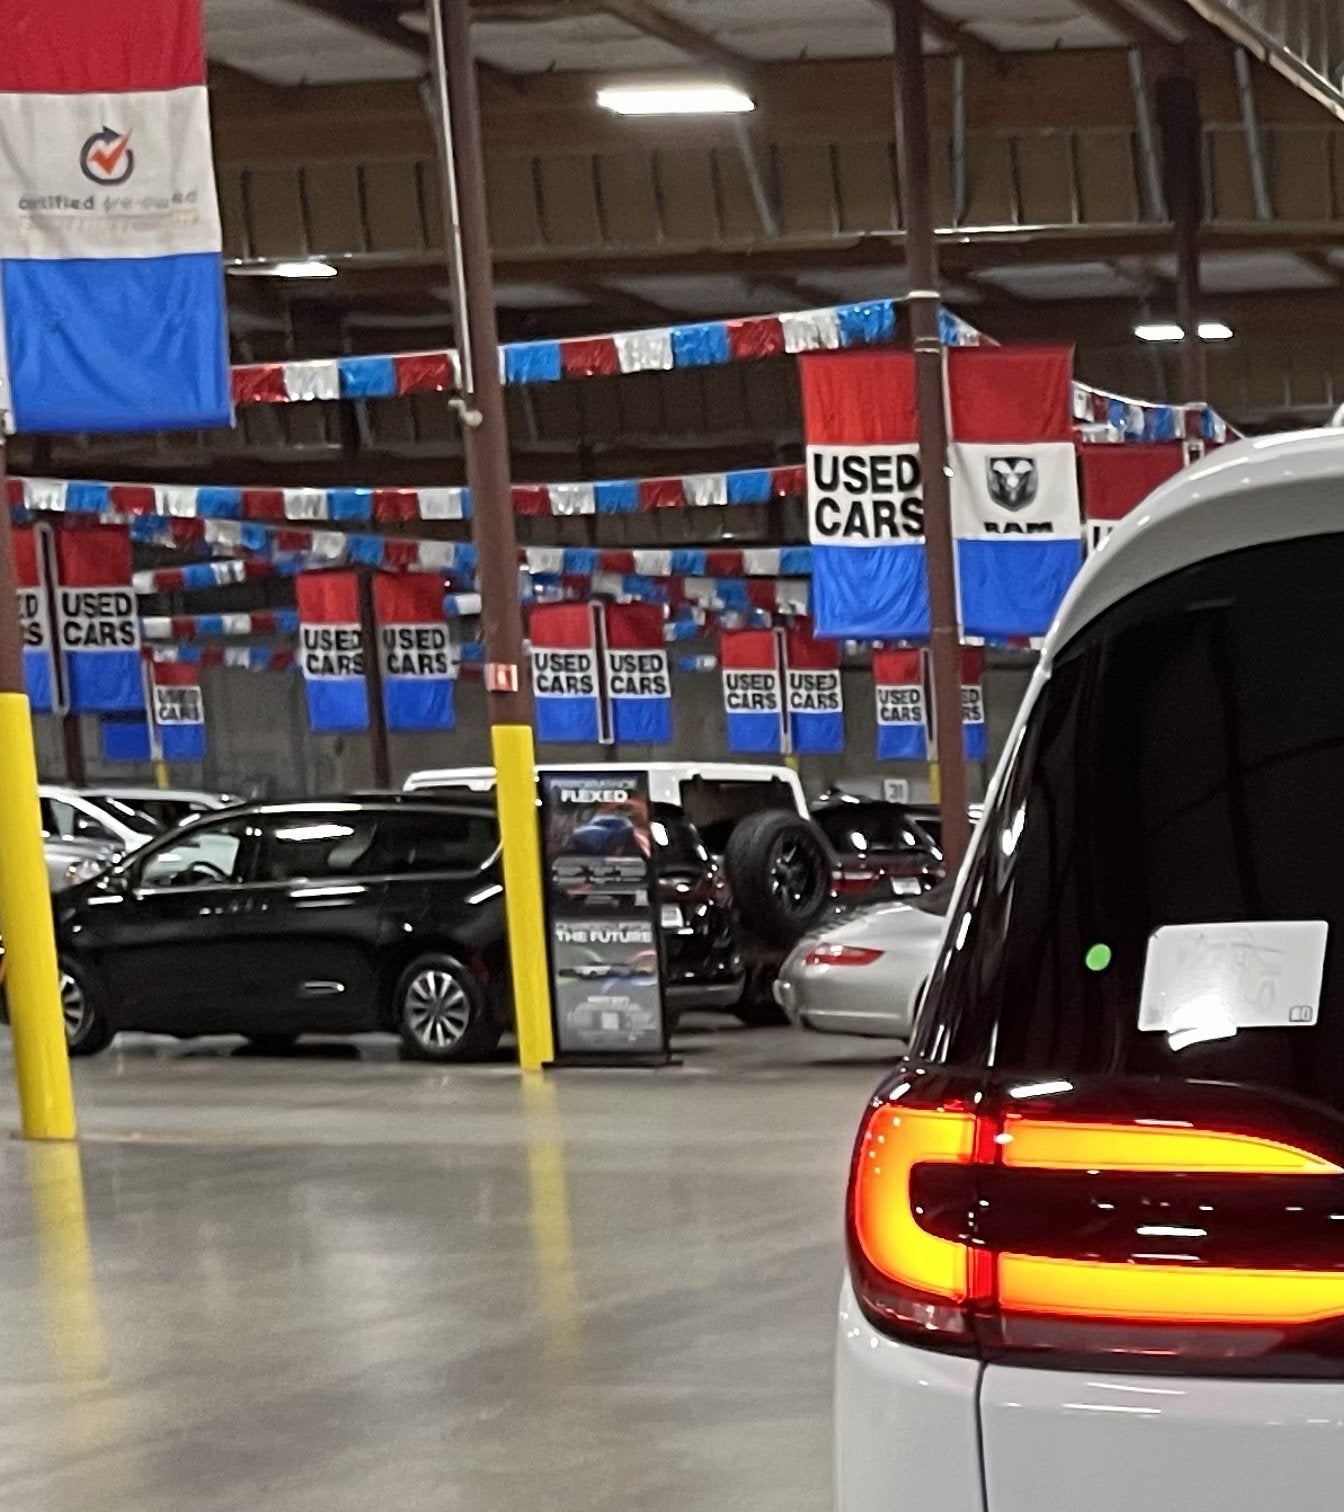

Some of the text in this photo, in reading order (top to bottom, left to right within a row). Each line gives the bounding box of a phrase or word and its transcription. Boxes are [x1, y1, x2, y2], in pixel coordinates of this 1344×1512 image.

[813, 453, 921, 495] USED
[814, 496, 924, 539] CARS
[62, 592, 132, 618] USED
[63, 620, 136, 646] CARS
[304, 628, 362, 651] USED
[383, 628, 446, 650] USED
[306, 652, 364, 675] CARS
[387, 652, 448, 675] CARS
[534, 653, 591, 673] USED
[609, 653, 664, 674] USED
[536, 674, 594, 694] CARS
[610, 675, 667, 695] CARS
[726, 673, 776, 691] USED
[789, 673, 837, 692] USED
[727, 691, 778, 710] CARS
[790, 692, 839, 710] CARS
[878, 688, 920, 705] USED
[880, 706, 923, 722] CARS
